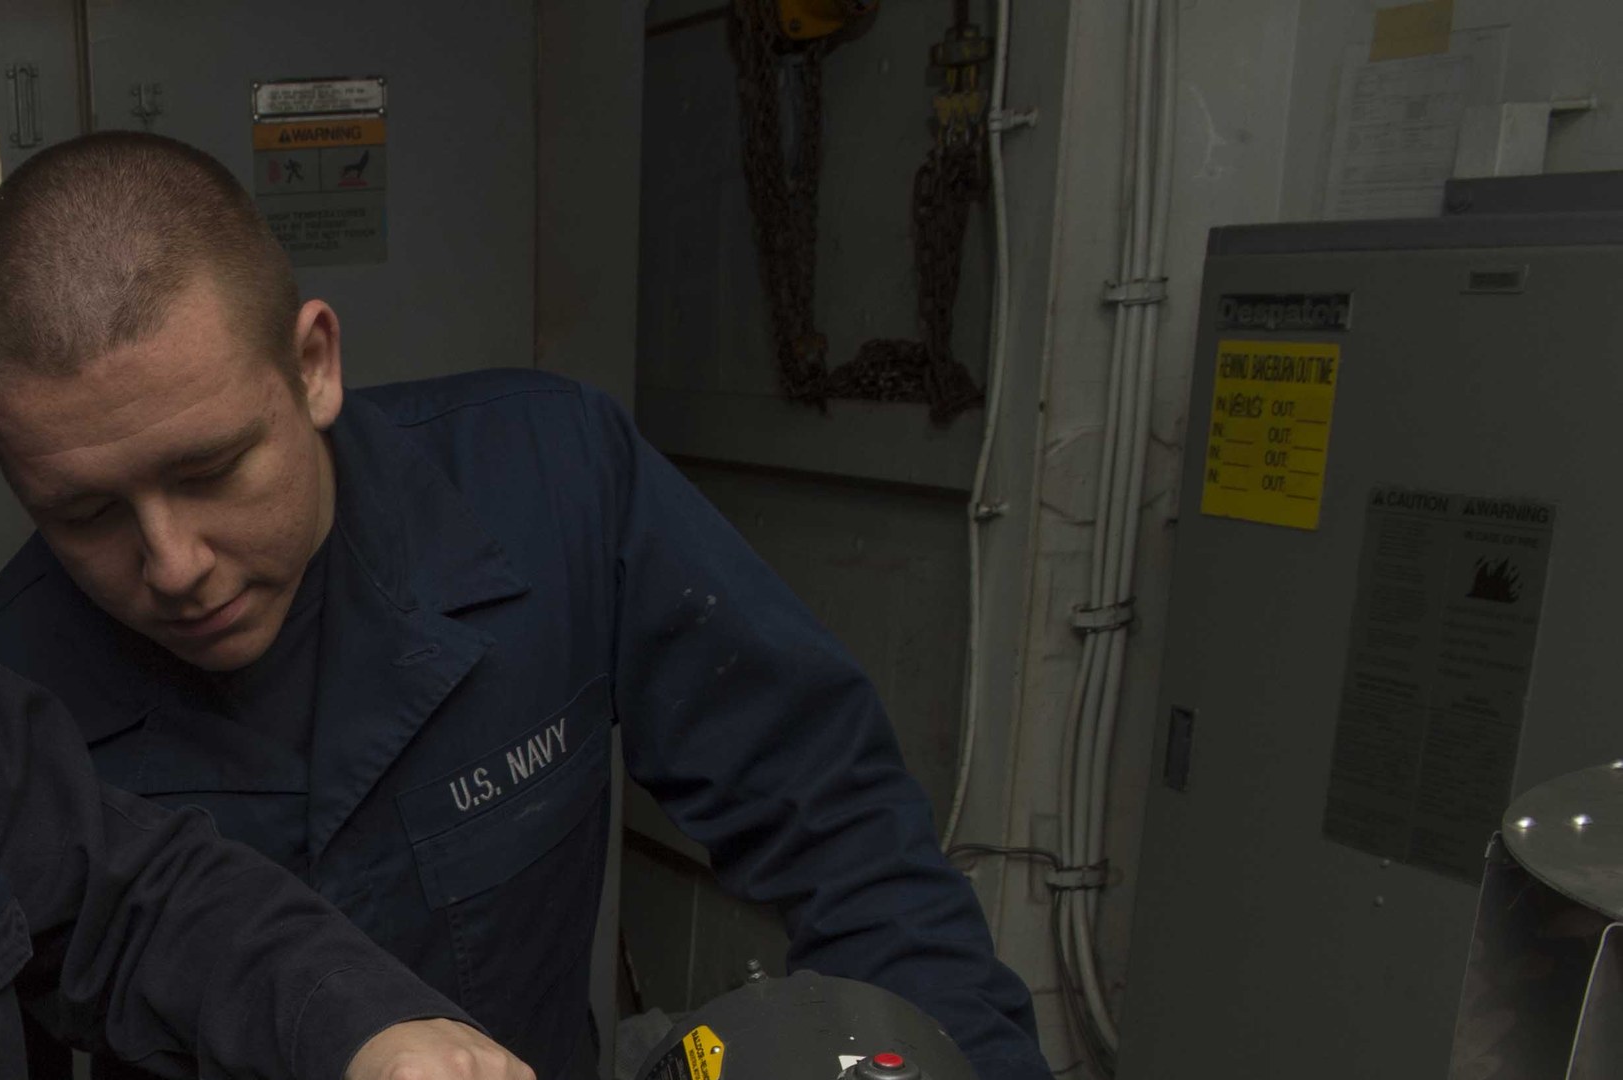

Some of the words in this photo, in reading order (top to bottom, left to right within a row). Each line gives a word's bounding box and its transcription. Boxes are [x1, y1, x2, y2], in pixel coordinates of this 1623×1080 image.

[292, 125, 362, 142] WARNING
[1386, 491, 1449, 514] CAUTION
[1474, 501, 1549, 524] WARNING
[449, 766, 503, 812] U.S.
[506, 717, 568, 785] NAVY
